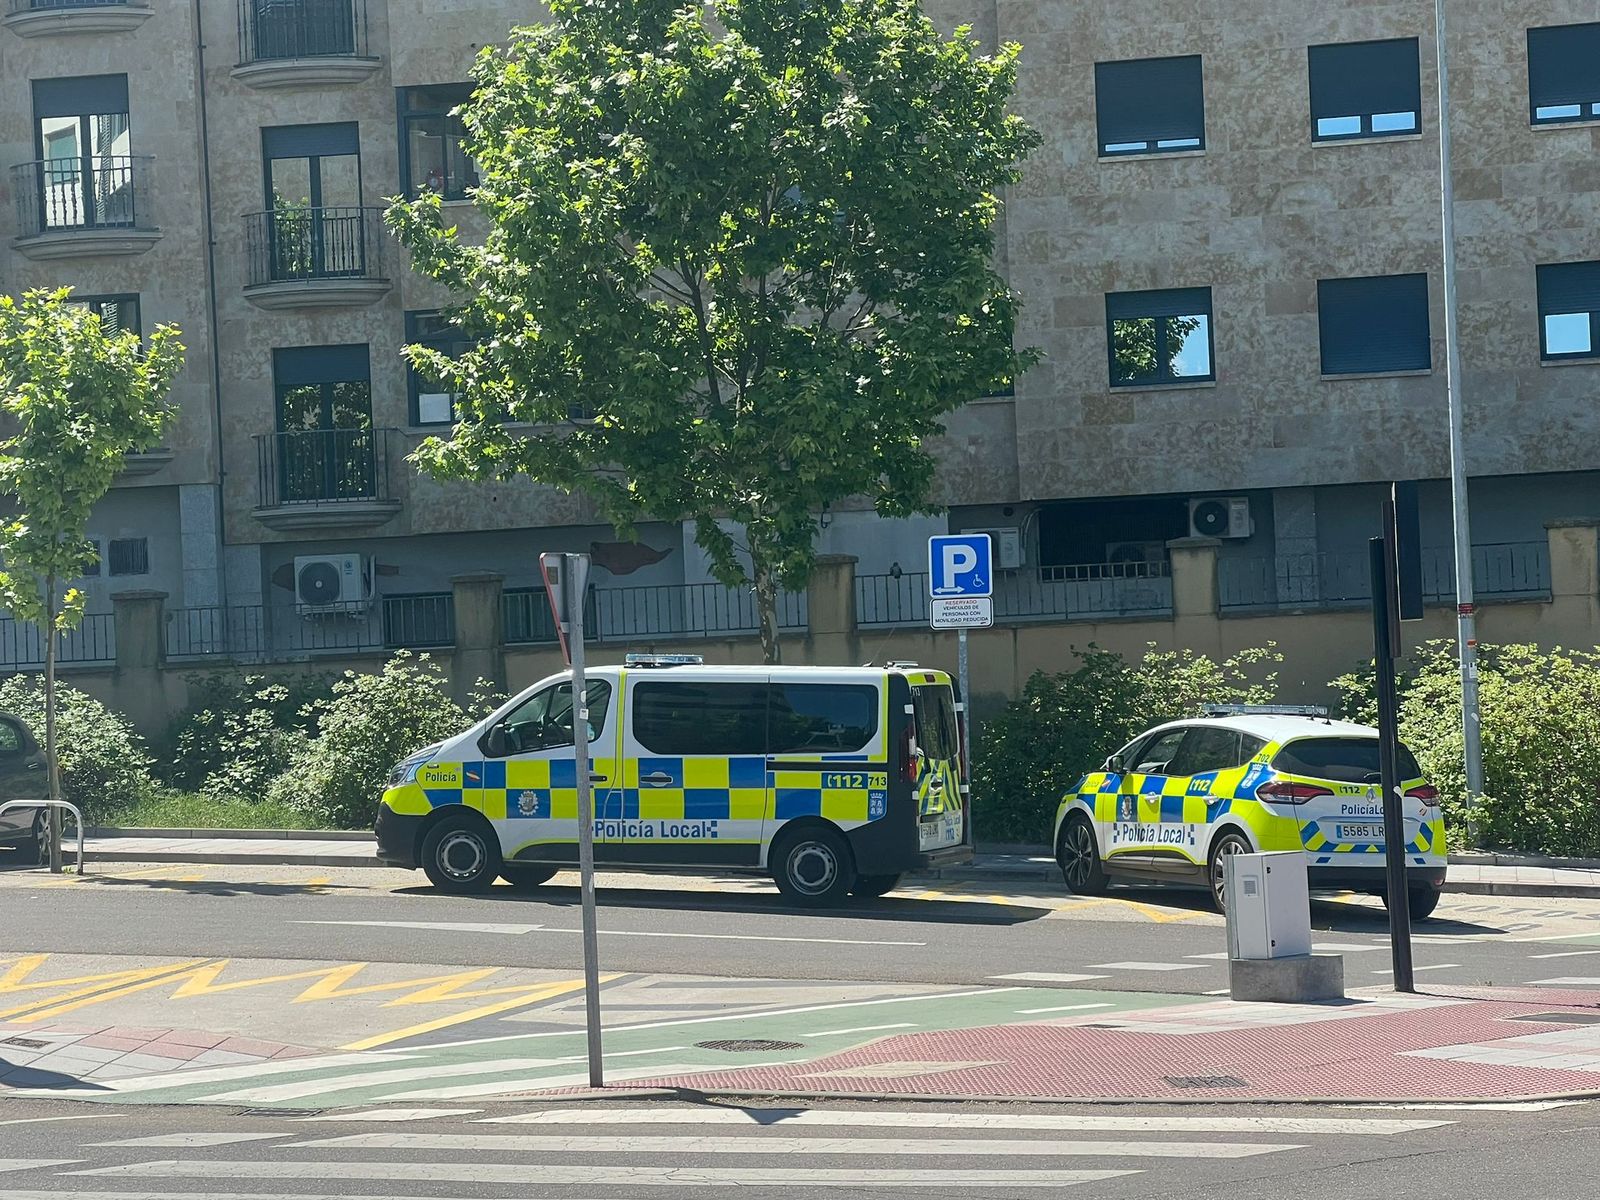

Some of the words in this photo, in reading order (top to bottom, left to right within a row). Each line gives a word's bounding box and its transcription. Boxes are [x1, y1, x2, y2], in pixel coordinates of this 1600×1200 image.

[943, 544, 977, 588] P
[1257, 753, 1270, 763] 702
[425, 771, 457, 782] Policía
[868, 776, 887, 786] 713
[594, 820, 654, 838] Policía
[661, 820, 706, 838] Local
[1122, 823, 1155, 842] Policía
[1157, 824, 1186, 844] Local
[1343, 826, 1369, 837] 5585
[1372, 826, 1385, 837] LR
